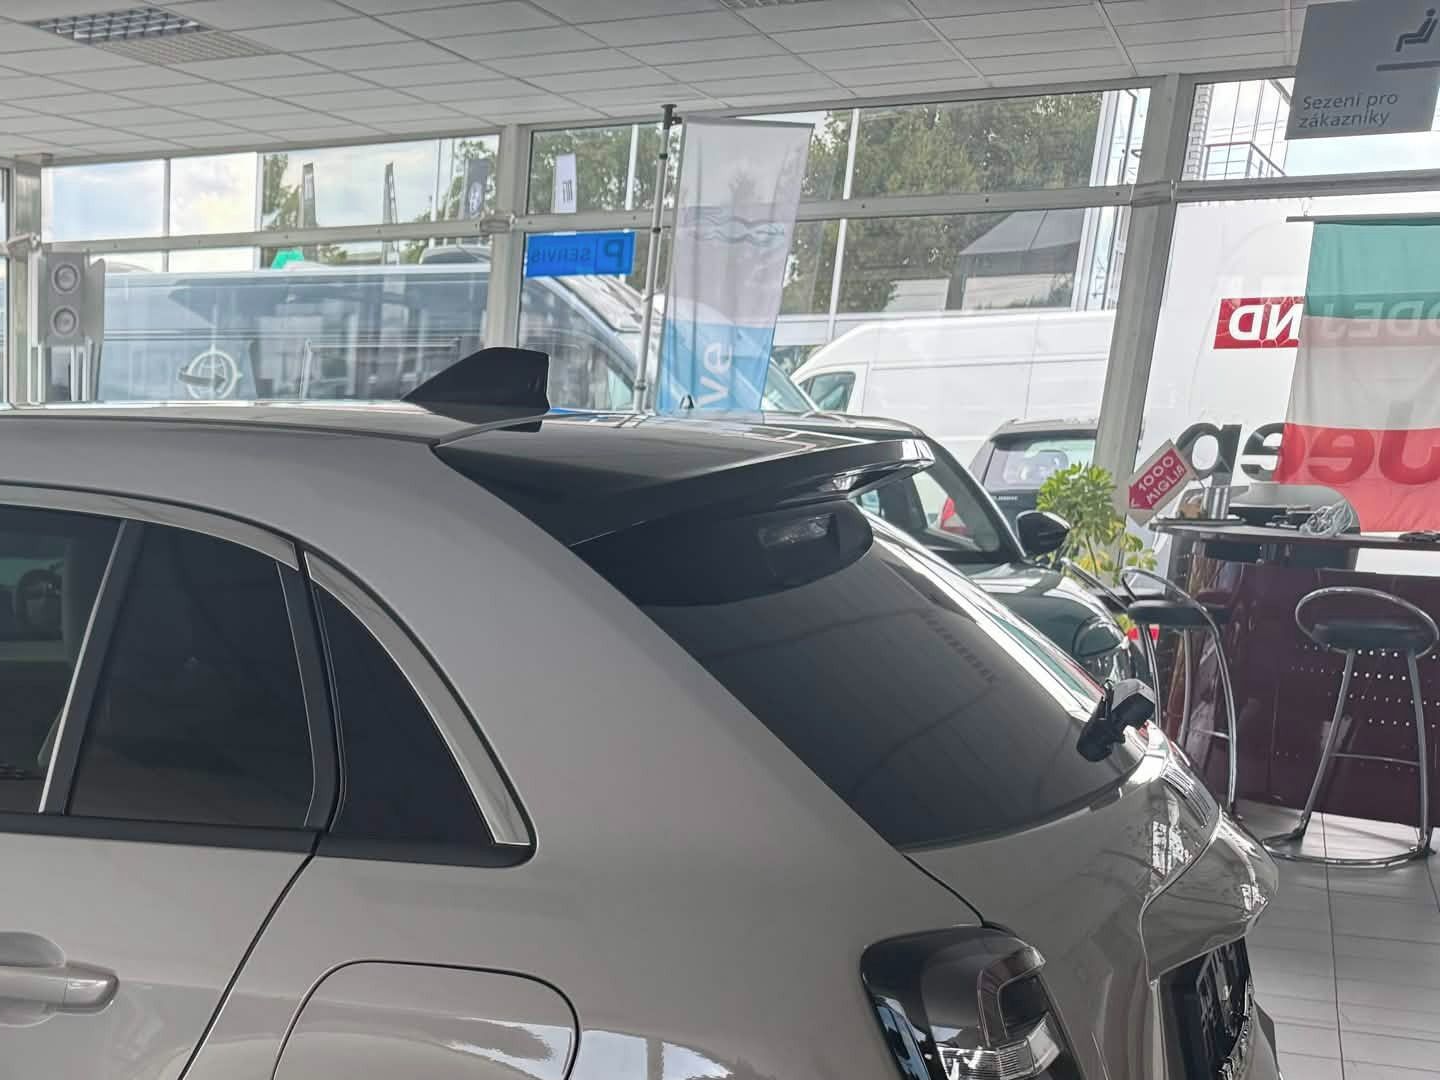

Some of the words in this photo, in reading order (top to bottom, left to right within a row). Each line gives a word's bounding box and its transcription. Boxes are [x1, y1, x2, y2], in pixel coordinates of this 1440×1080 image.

[1303, 92, 1361, 110] Sezení
[1367, 94, 1399, 112] pro
[1298, 108, 1390, 128] zákazníky
[1138, 456, 1174, 491] 1000
